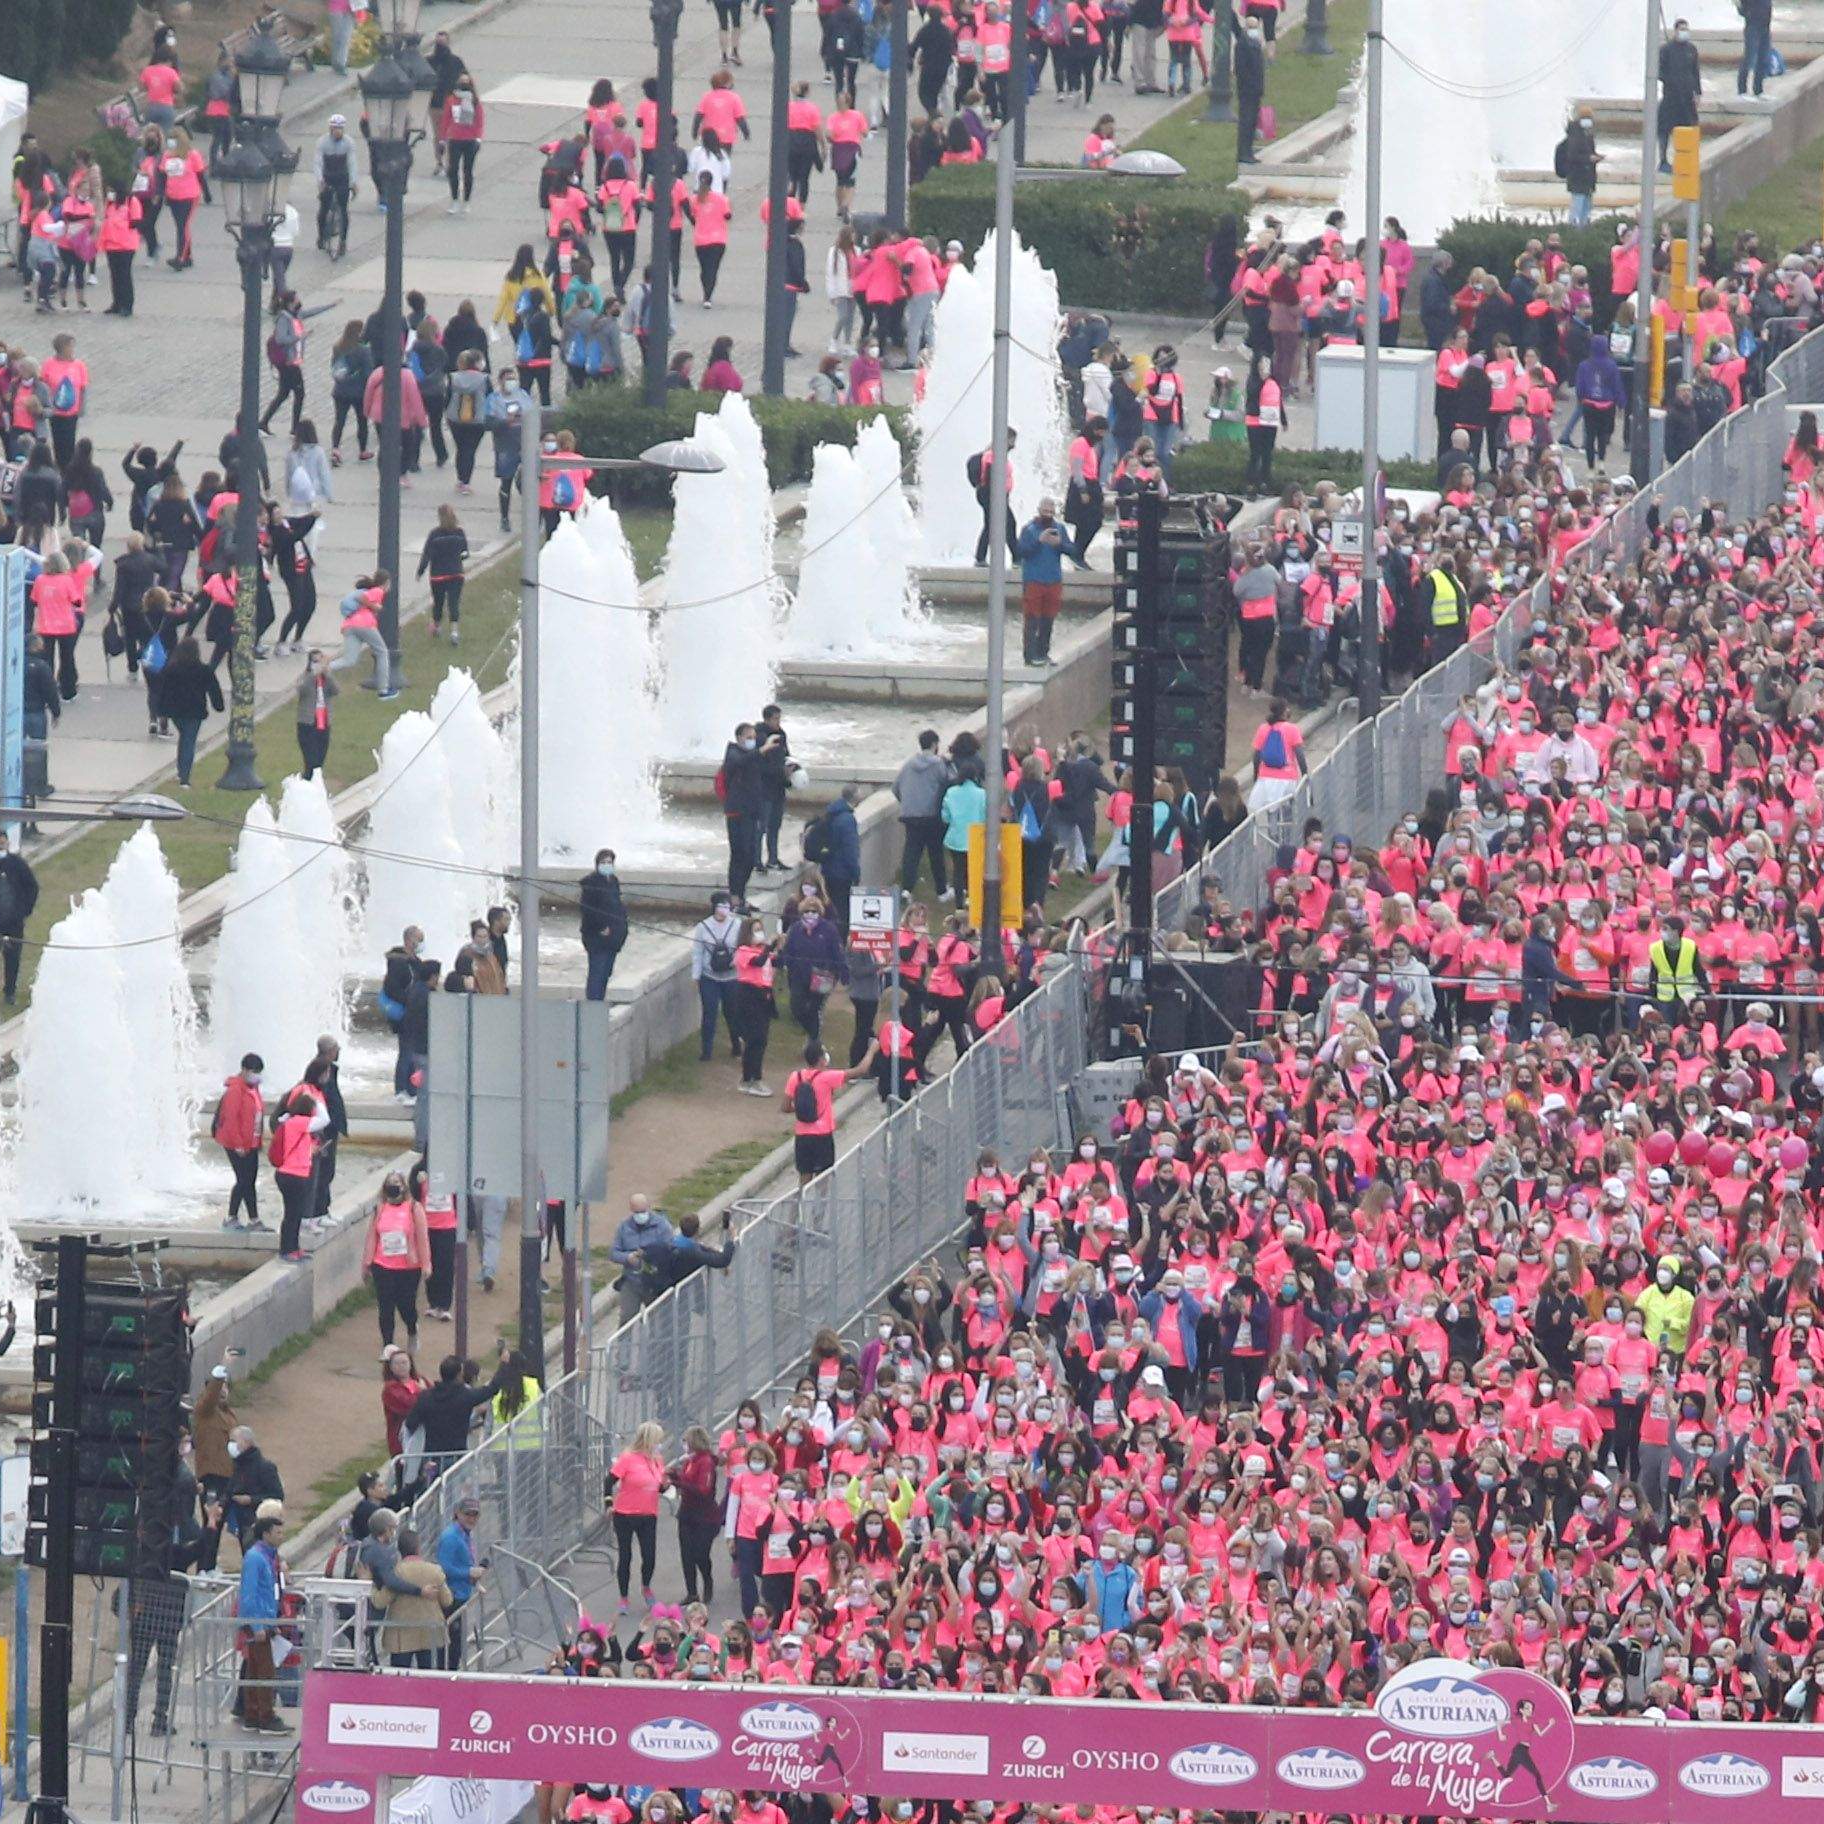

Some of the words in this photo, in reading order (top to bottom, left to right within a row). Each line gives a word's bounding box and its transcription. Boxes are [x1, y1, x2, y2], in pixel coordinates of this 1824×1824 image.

[1389, 1696, 1500, 1723] ASTURIANA
[358, 1718, 427, 1735] Santander
[746, 1714, 816, 1731] ASTURIANA
[527, 1722, 618, 1747] OYSHO
[636, 1731, 713, 1751] ASTURIANA
[450, 1737, 511, 1754] ZURICH
[731, 1735, 800, 1757] Carrera
[911, 1746, 978, 1761] Santander
[1365, 1730, 1474, 1767] Carrera
[1072, 1749, 1160, 1772] OYSHO
[1175, 1758, 1251, 1776] ASTURIANA
[770, 1756, 824, 1789] Mujer
[1002, 1763, 1065, 1779] ZURICH
[1283, 1762, 1359, 1780] ASTURIANA
[1575, 1770, 1651, 1791] ASTURIANA
[1685, 1767, 1762, 1788] ASTURIANA
[307, 1790, 365, 1805] ASTURIANA
[1391, 1766, 1413, 1788] de
[1415, 1768, 1431, 1789] la
[1427, 1762, 1514, 1813] Mujer
